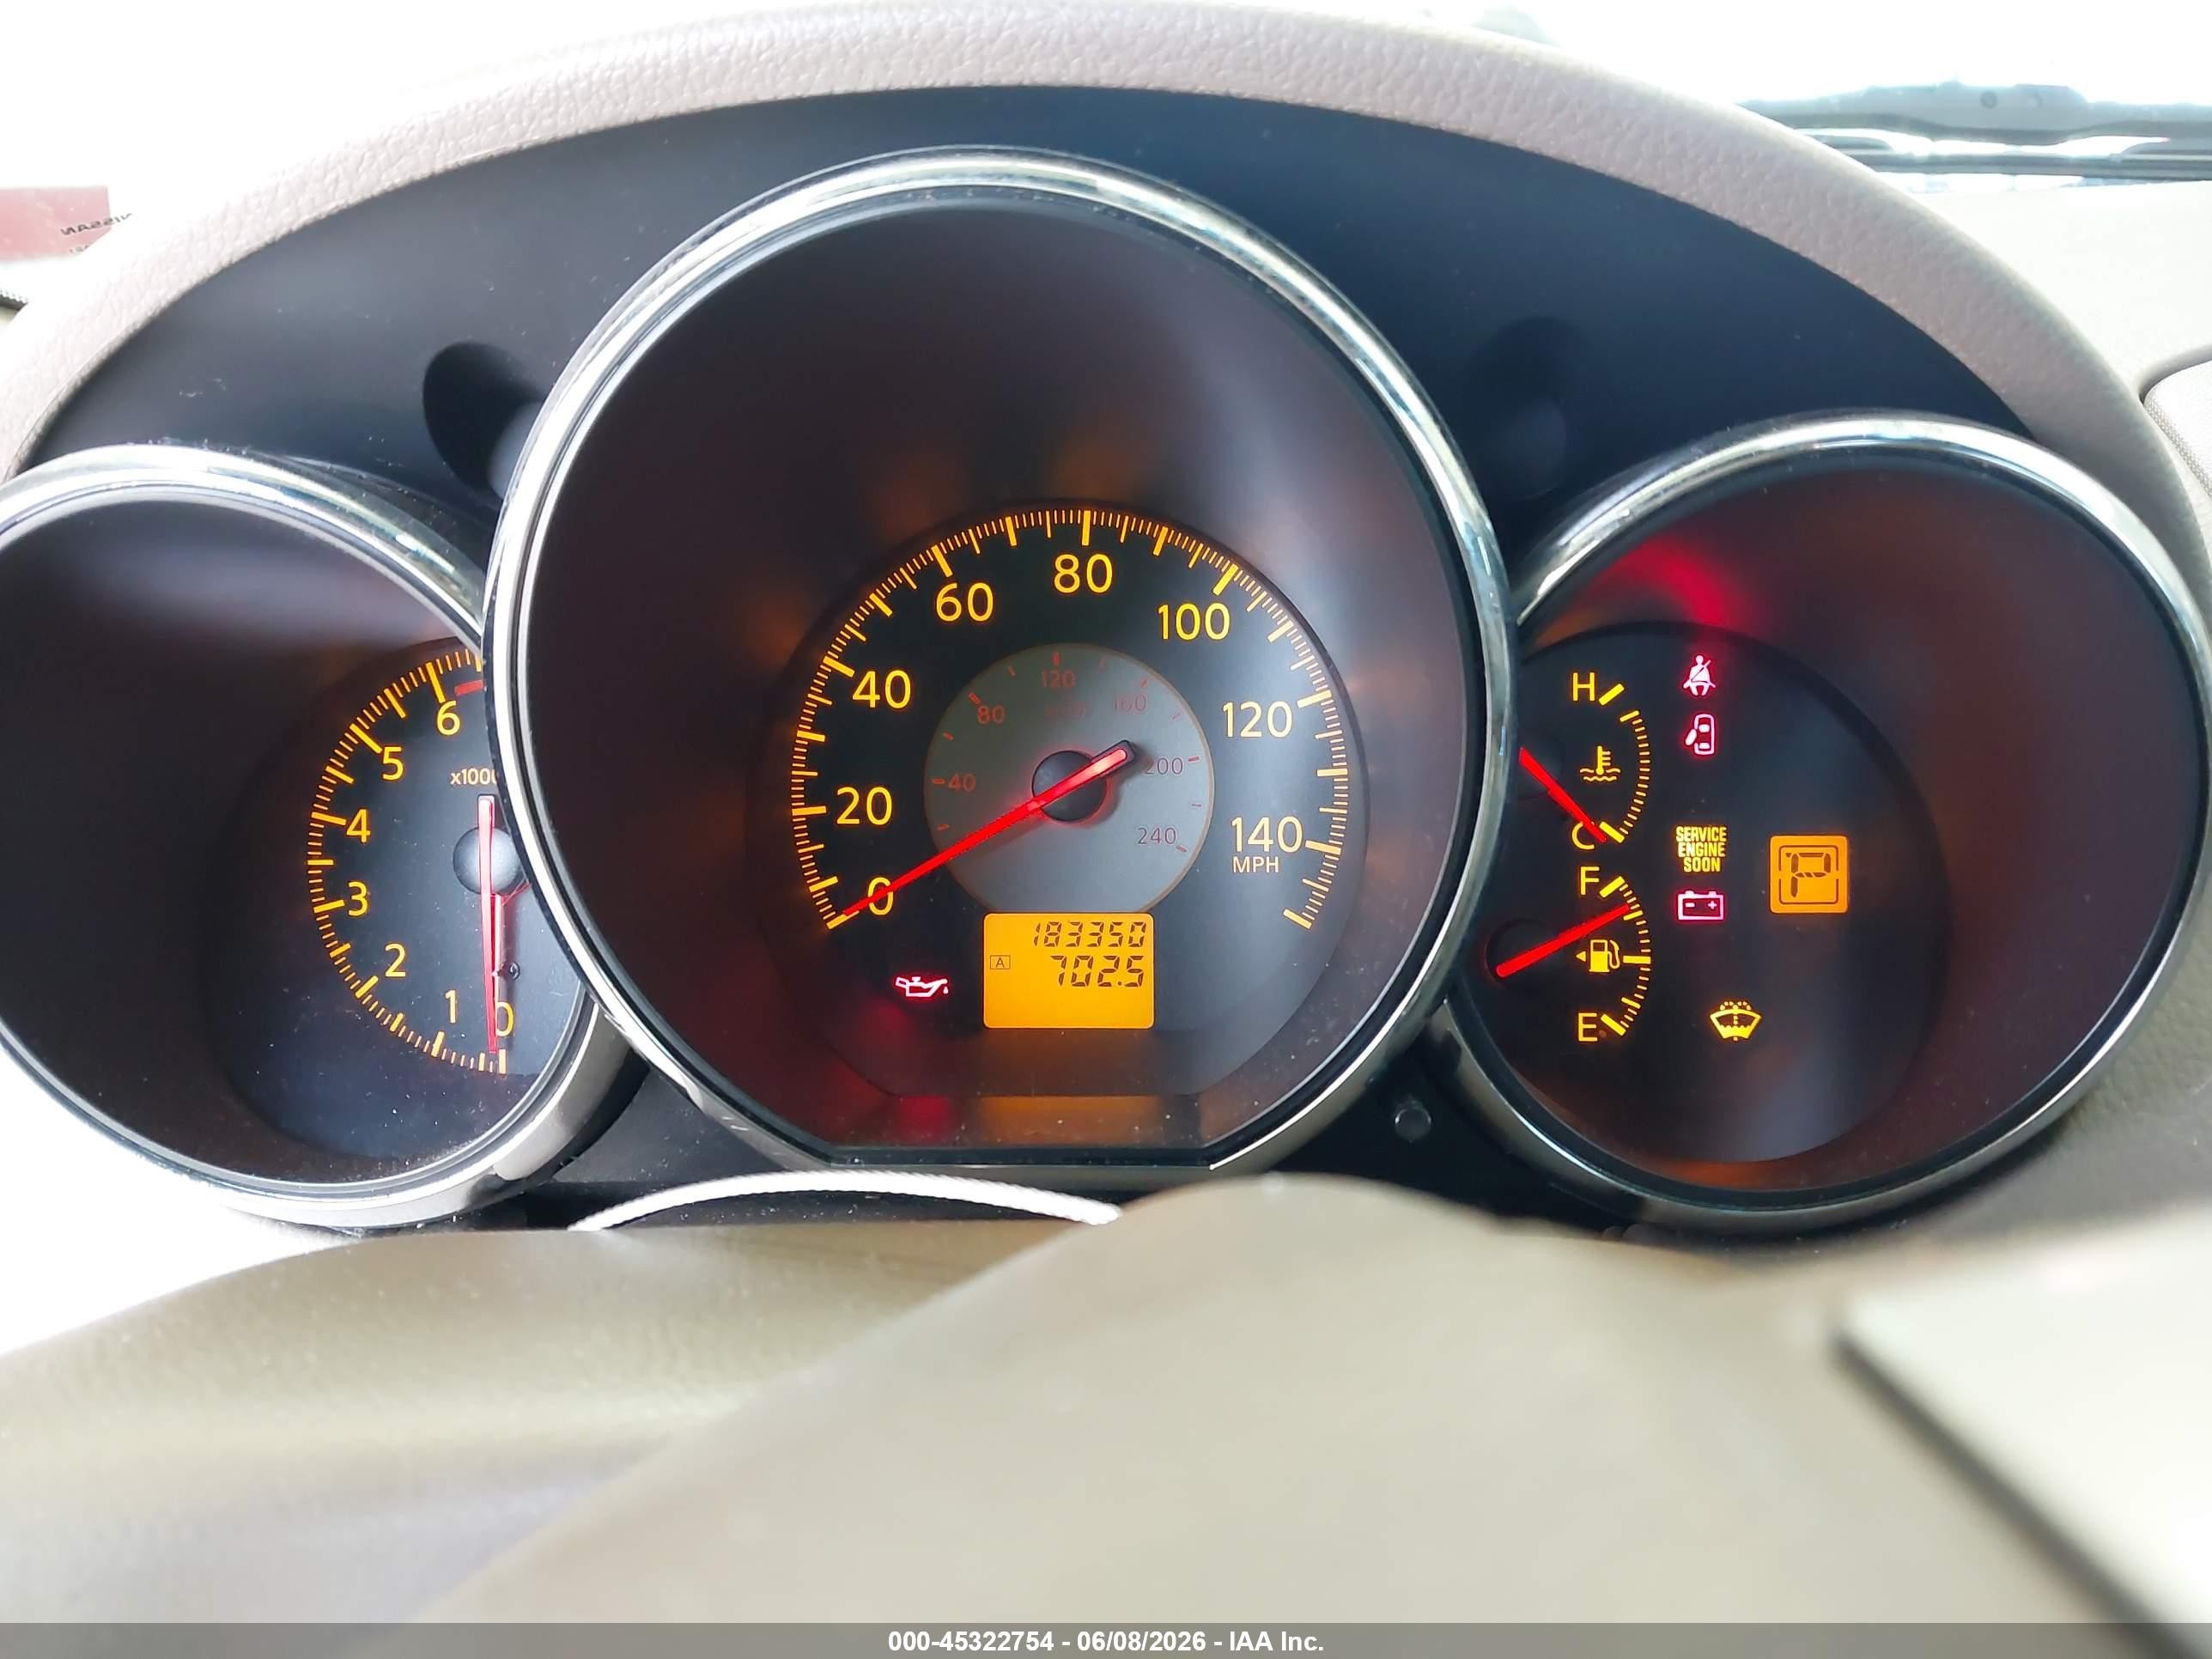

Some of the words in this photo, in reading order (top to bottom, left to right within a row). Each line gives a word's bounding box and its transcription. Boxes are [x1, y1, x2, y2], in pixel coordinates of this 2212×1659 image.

[1054, 554, 1113, 593] 80
[936, 582, 994, 622] 60
[1158, 603, 1230, 640] 100
[852, 670, 911, 708] 40
[1042, 671, 1076, 688] 120
[1572, 672, 1595, 702] H
[436, 700, 461, 736] 6
[977, 706, 1005, 723] 80
[1223, 701, 1292, 738] 120
[381, 745, 404, 781] 5
[948, 774, 976, 792] 40
[836, 787, 892, 825] 20
[346, 809, 370, 843] 4
[1137, 827, 1177, 845] 240
[1231, 816, 1304, 853] 140
[1571, 822, 1596, 850] C
[1675, 825, 1727, 842] SERVICE
[1233, 857, 1279, 873] MPH
[1678, 842, 1726, 857] ENGINE
[1683, 857, 1721, 872] SOON
[1580, 866, 1599, 895] F
[1785, 852, 1832, 898] P
[347, 881, 368, 917] 3
[867, 877, 894, 915] 0
[1033, 921, 1146, 947] 183350
[385, 944, 406, 976] 2
[1050, 955, 1145, 987] 702.5
[444, 990, 457, 1023] 1
[495, 1001, 514, 1036] 0
[1578, 1012, 1598, 1042] E
